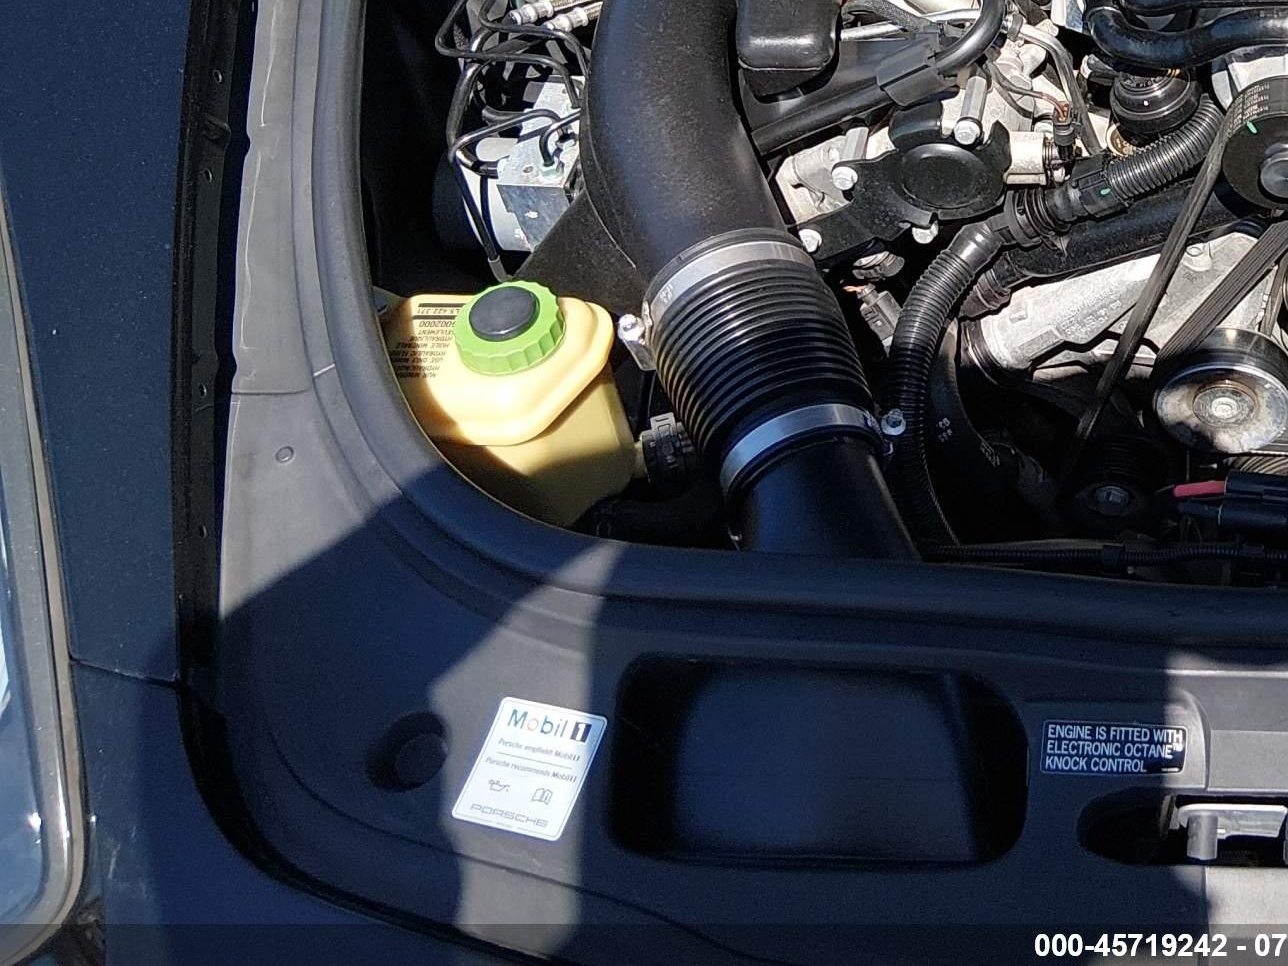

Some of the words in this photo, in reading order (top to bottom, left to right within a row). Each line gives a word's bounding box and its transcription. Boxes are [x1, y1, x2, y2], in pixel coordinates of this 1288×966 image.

[507, 708, 568, 738] Mobil
[1047, 724, 1093, 740] ENGINE
[1095, 725, 1107, 740] IS
[1109, 726, 1150, 741] FITTED
[1152, 729, 1183, 744] WITH
[1046, 741, 1121, 757] ELECTRONIC
[1045, 756, 1088, 771] KNOCK
[1090, 758, 1148, 773] CONTROL
[469, 803, 550, 828] PORSCHE
